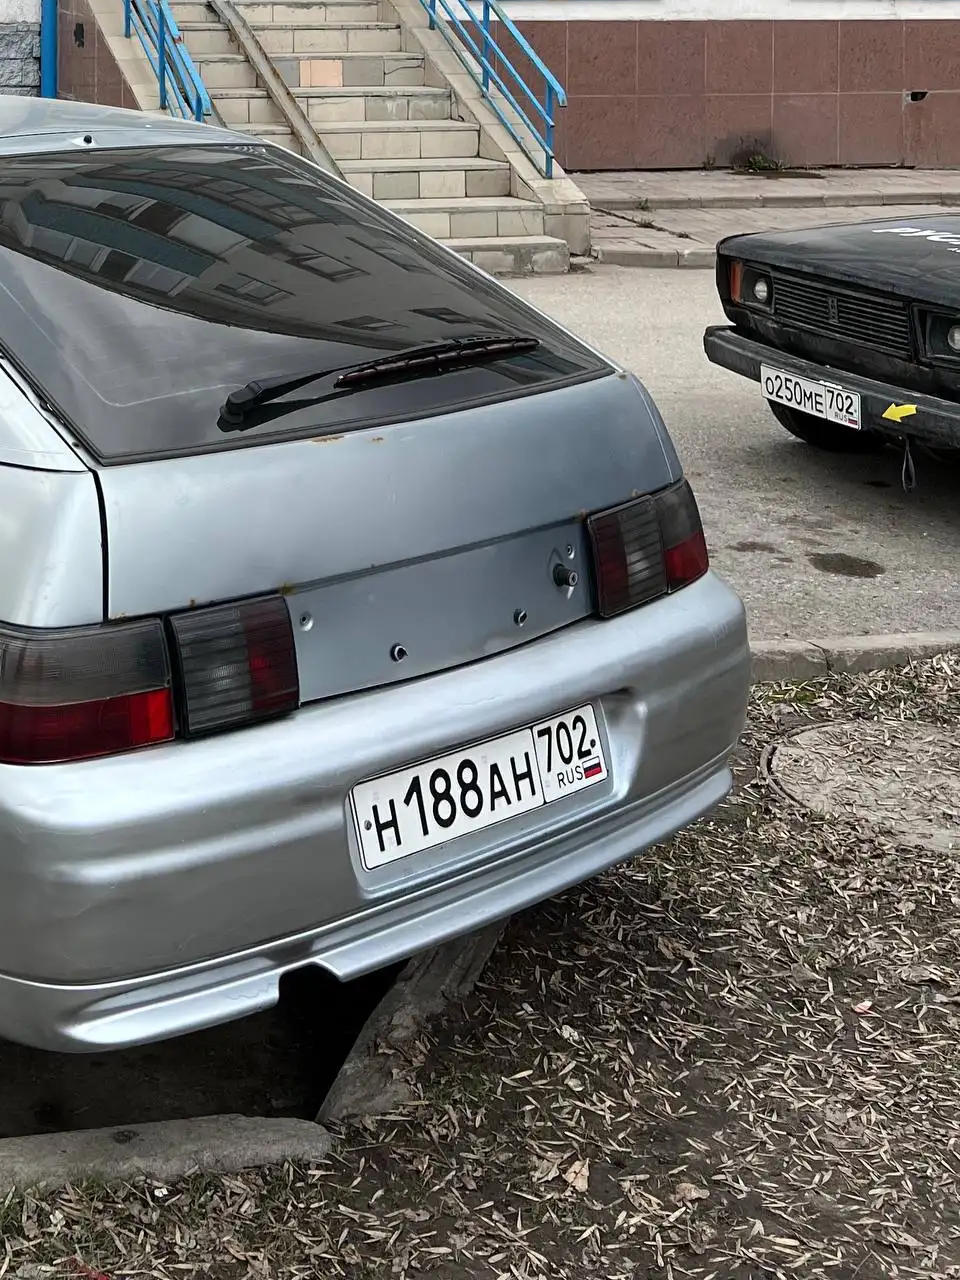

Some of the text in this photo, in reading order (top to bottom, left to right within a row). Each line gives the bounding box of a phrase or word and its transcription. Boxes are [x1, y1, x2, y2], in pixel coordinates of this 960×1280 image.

[765, 374, 854, 416] О250МЕ 702
[834, 411, 848, 423] RUS
[372, 715, 592, 852] Н188АН 702
[556, 768, 584, 789] RUS
